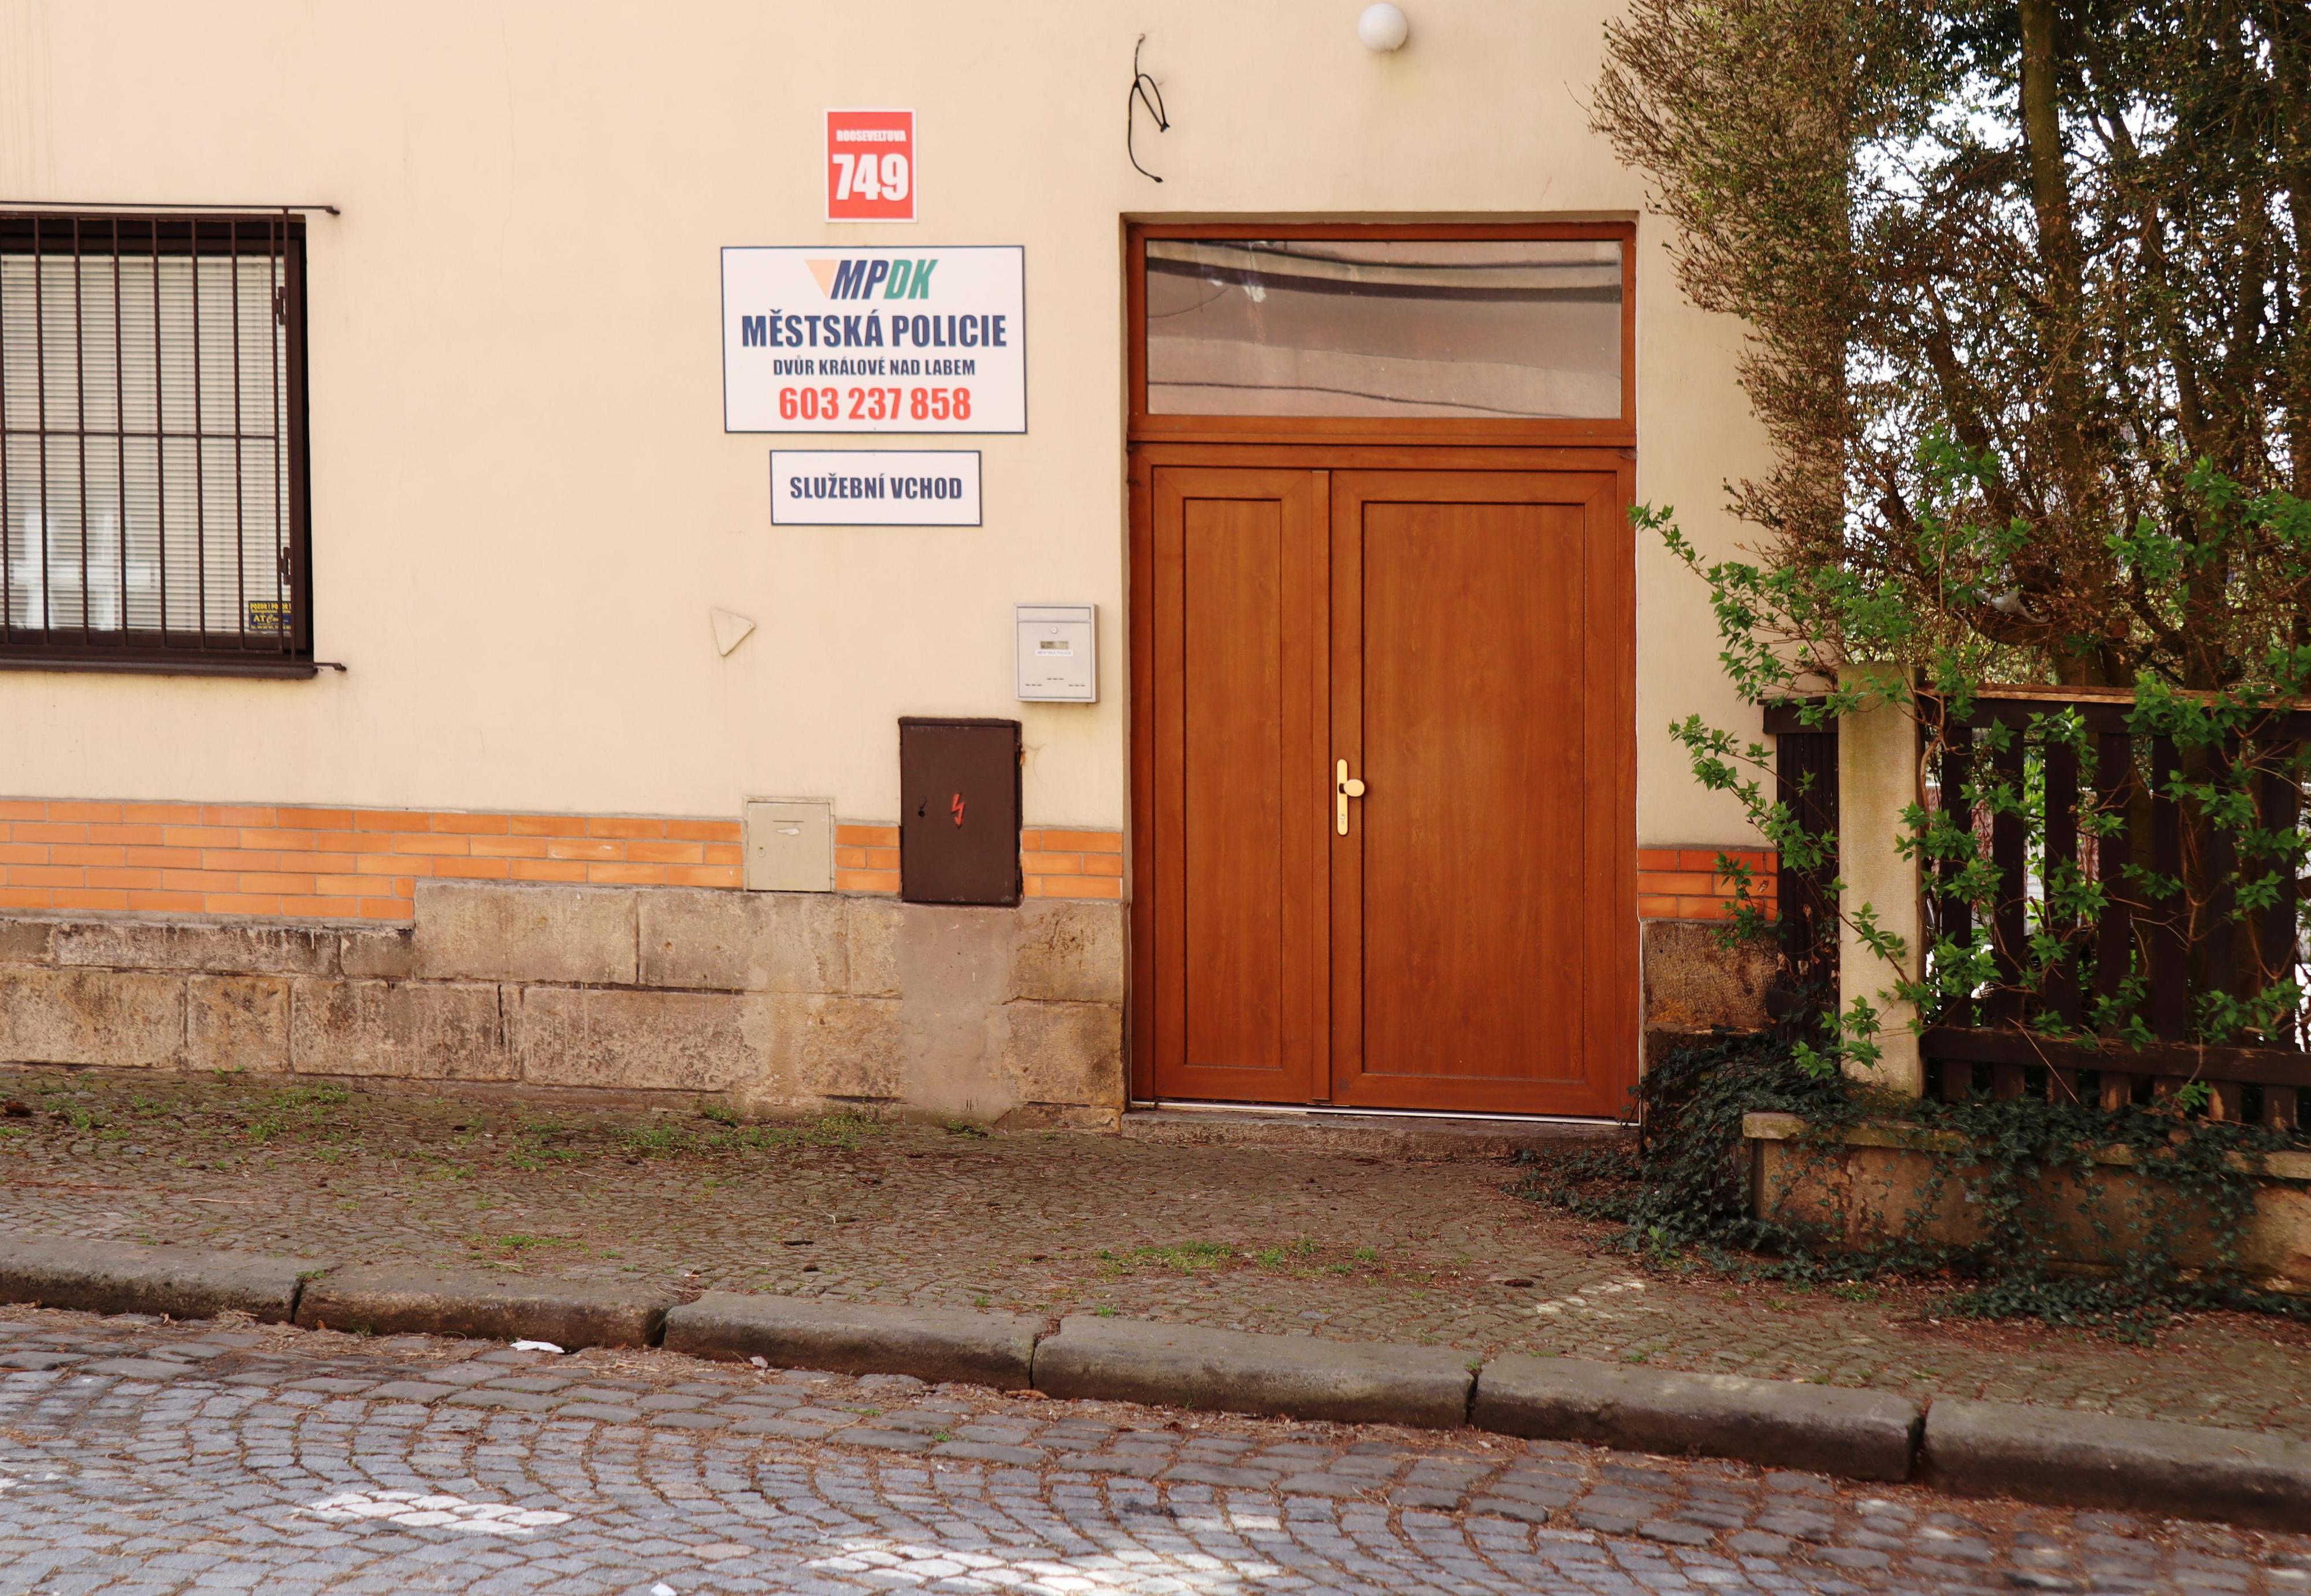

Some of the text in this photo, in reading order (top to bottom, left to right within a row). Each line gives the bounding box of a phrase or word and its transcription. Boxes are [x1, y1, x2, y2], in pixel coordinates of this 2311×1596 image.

[836, 129, 906, 142] ROOSEVELTOVA
[833, 153, 909, 201] 749
[830, 259, 939, 300] MPDK
[742, 308, 1007, 348] MĚSTSKÁ POLICIE
[773, 356, 975, 376] DVŮR KRÁLOVÉ NAD LABEM
[779, 387, 971, 421] 603 237 858
[790, 473, 962, 500] SLUŽEBNÍ VCHOD
